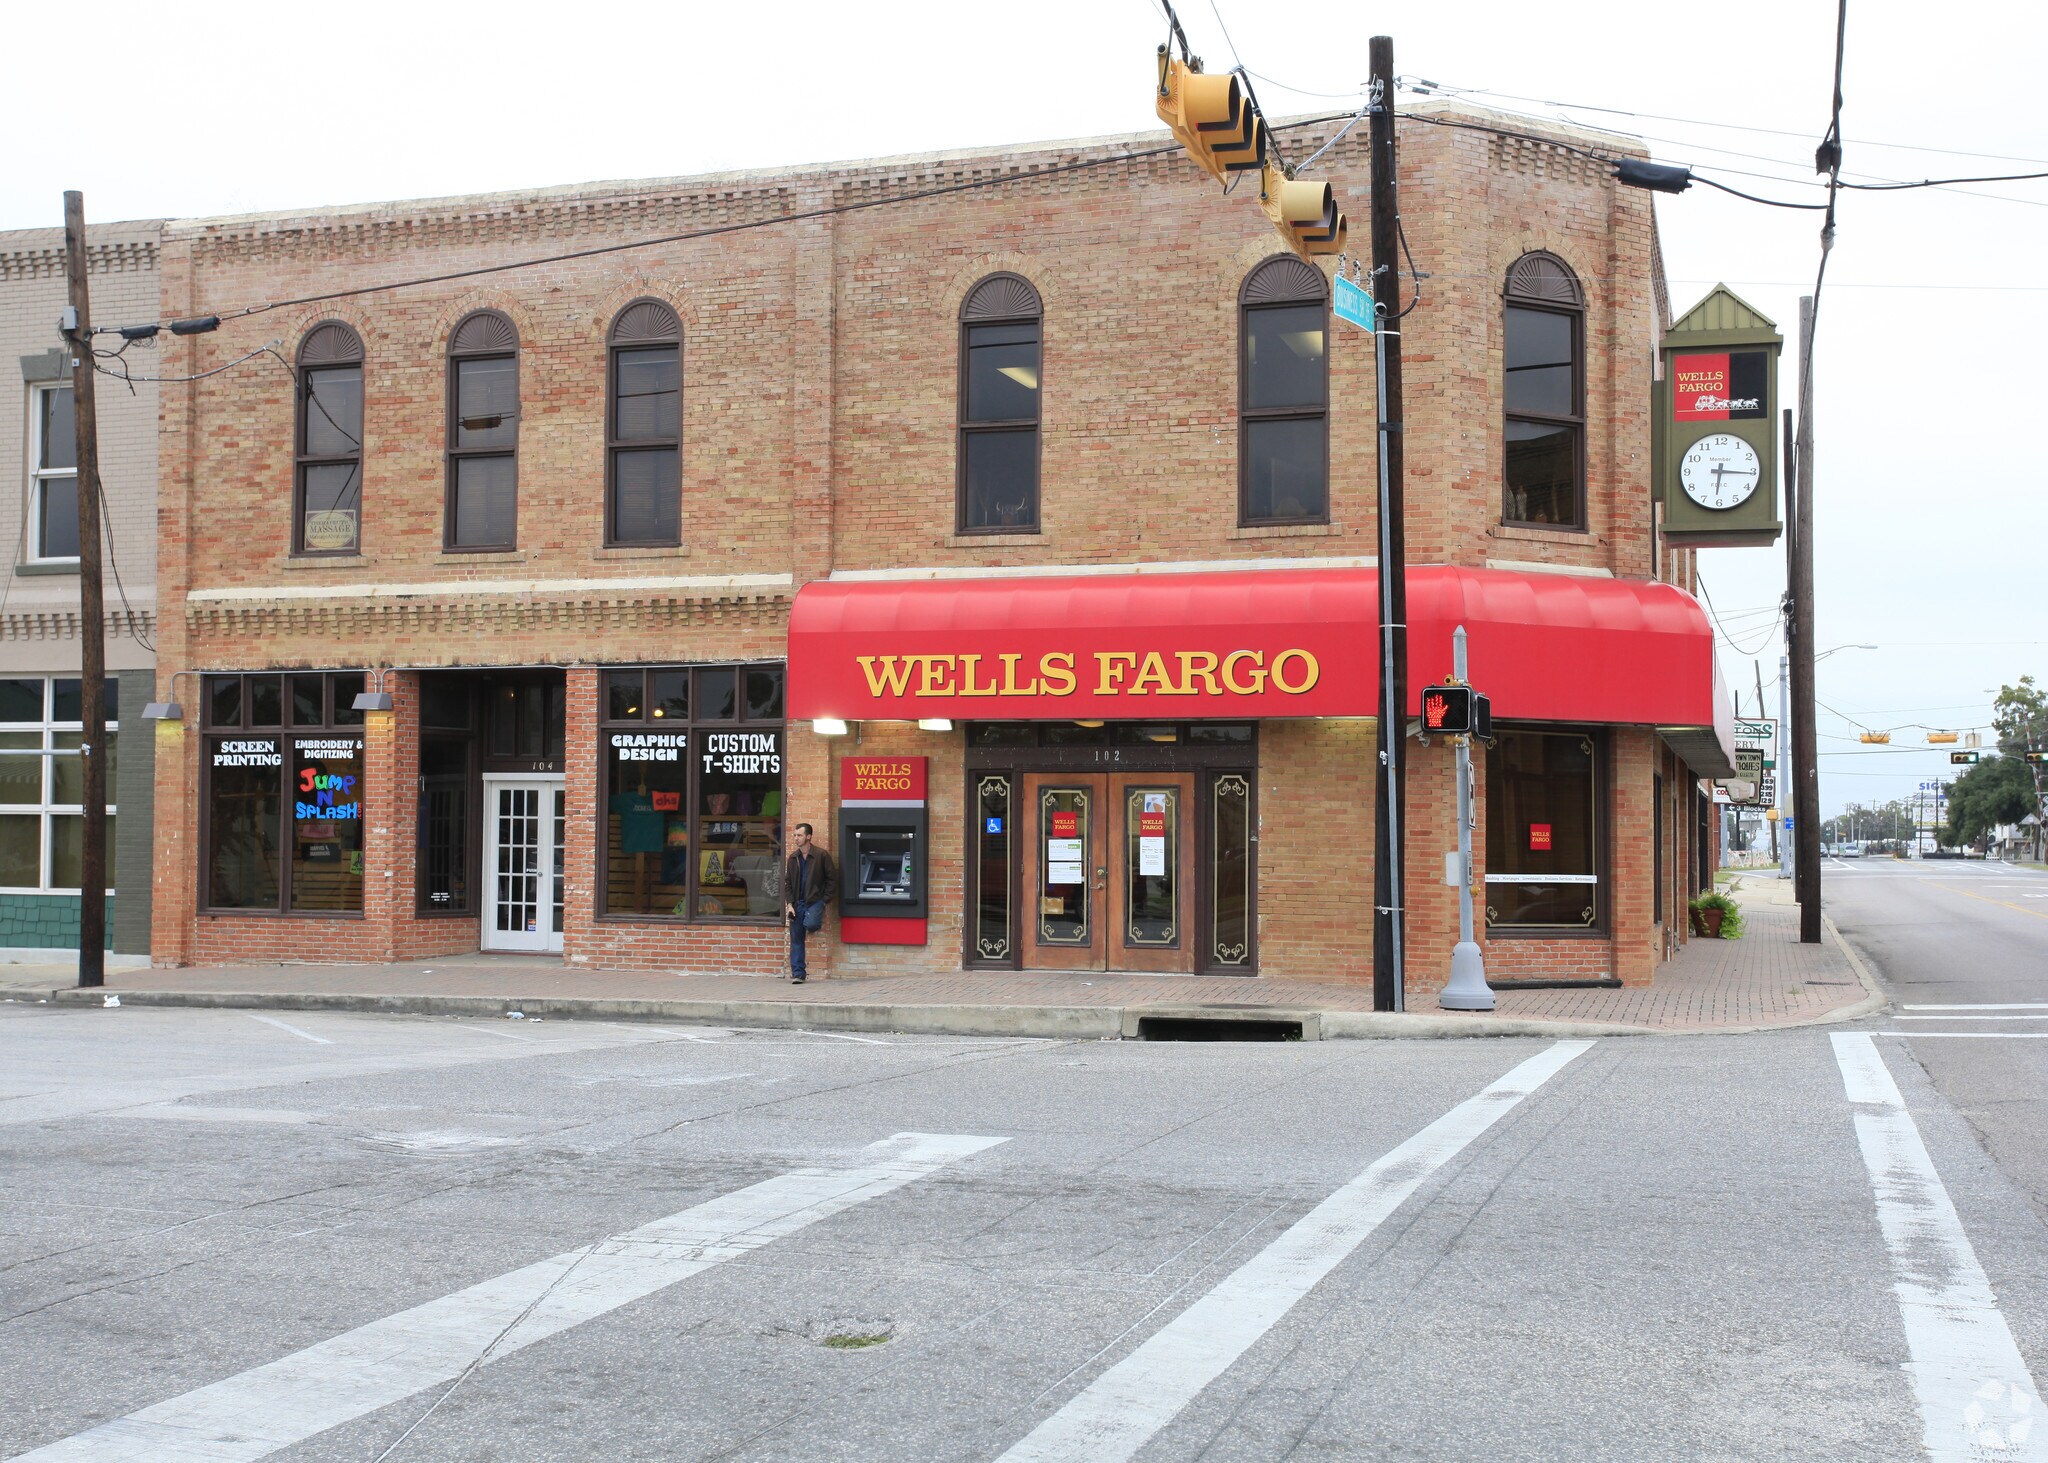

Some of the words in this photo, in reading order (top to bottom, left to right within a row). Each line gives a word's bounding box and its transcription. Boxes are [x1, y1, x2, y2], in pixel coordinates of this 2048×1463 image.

[1677, 371, 1724, 382] WELLS
[1678, 382, 1724, 393] FARGO
[1699, 442, 1711, 451] 11
[1714, 437, 1728, 446] 12
[1735, 441, 1741, 450] 1
[1688, 454, 1701, 463] 10
[1745, 453, 1753, 461] 2
[1683, 468, 1691, 477] 9
[1750, 467, 1757, 476] 3
[1688, 483, 1695, 491] 8
[1743, 483, 1751, 491] 4
[1700, 495, 1707, 503] 7
[1715, 498, 1723, 507] 6
[1732, 494, 1739, 503] 5
[310, 524, 351, 533] MASSAGE
[856, 651, 1078, 698] WELLS
[1092, 648, 1321, 697] FARGO
[295, 739, 354, 749] EMBROIDERY
[356, 739, 363, 749] &
[611, 734, 687, 748] GRAPHIC
[708, 733, 775, 753] CUSTOM
[221, 740, 275, 753] SCREEN
[304, 749, 354, 759] DIGITIZING
[619, 748, 678, 761] DESIGN
[1095, 750, 1120, 761] 102
[213, 753, 282, 767] PRINTING
[703, 754, 780, 774] T-SHIRTS
[532, 761, 553, 771] 104
[854, 763, 912, 776] WELLS
[855, 777, 911, 790] FARGO
[317, 790, 333, 807] N
[295, 801, 358, 819] SPLASH
